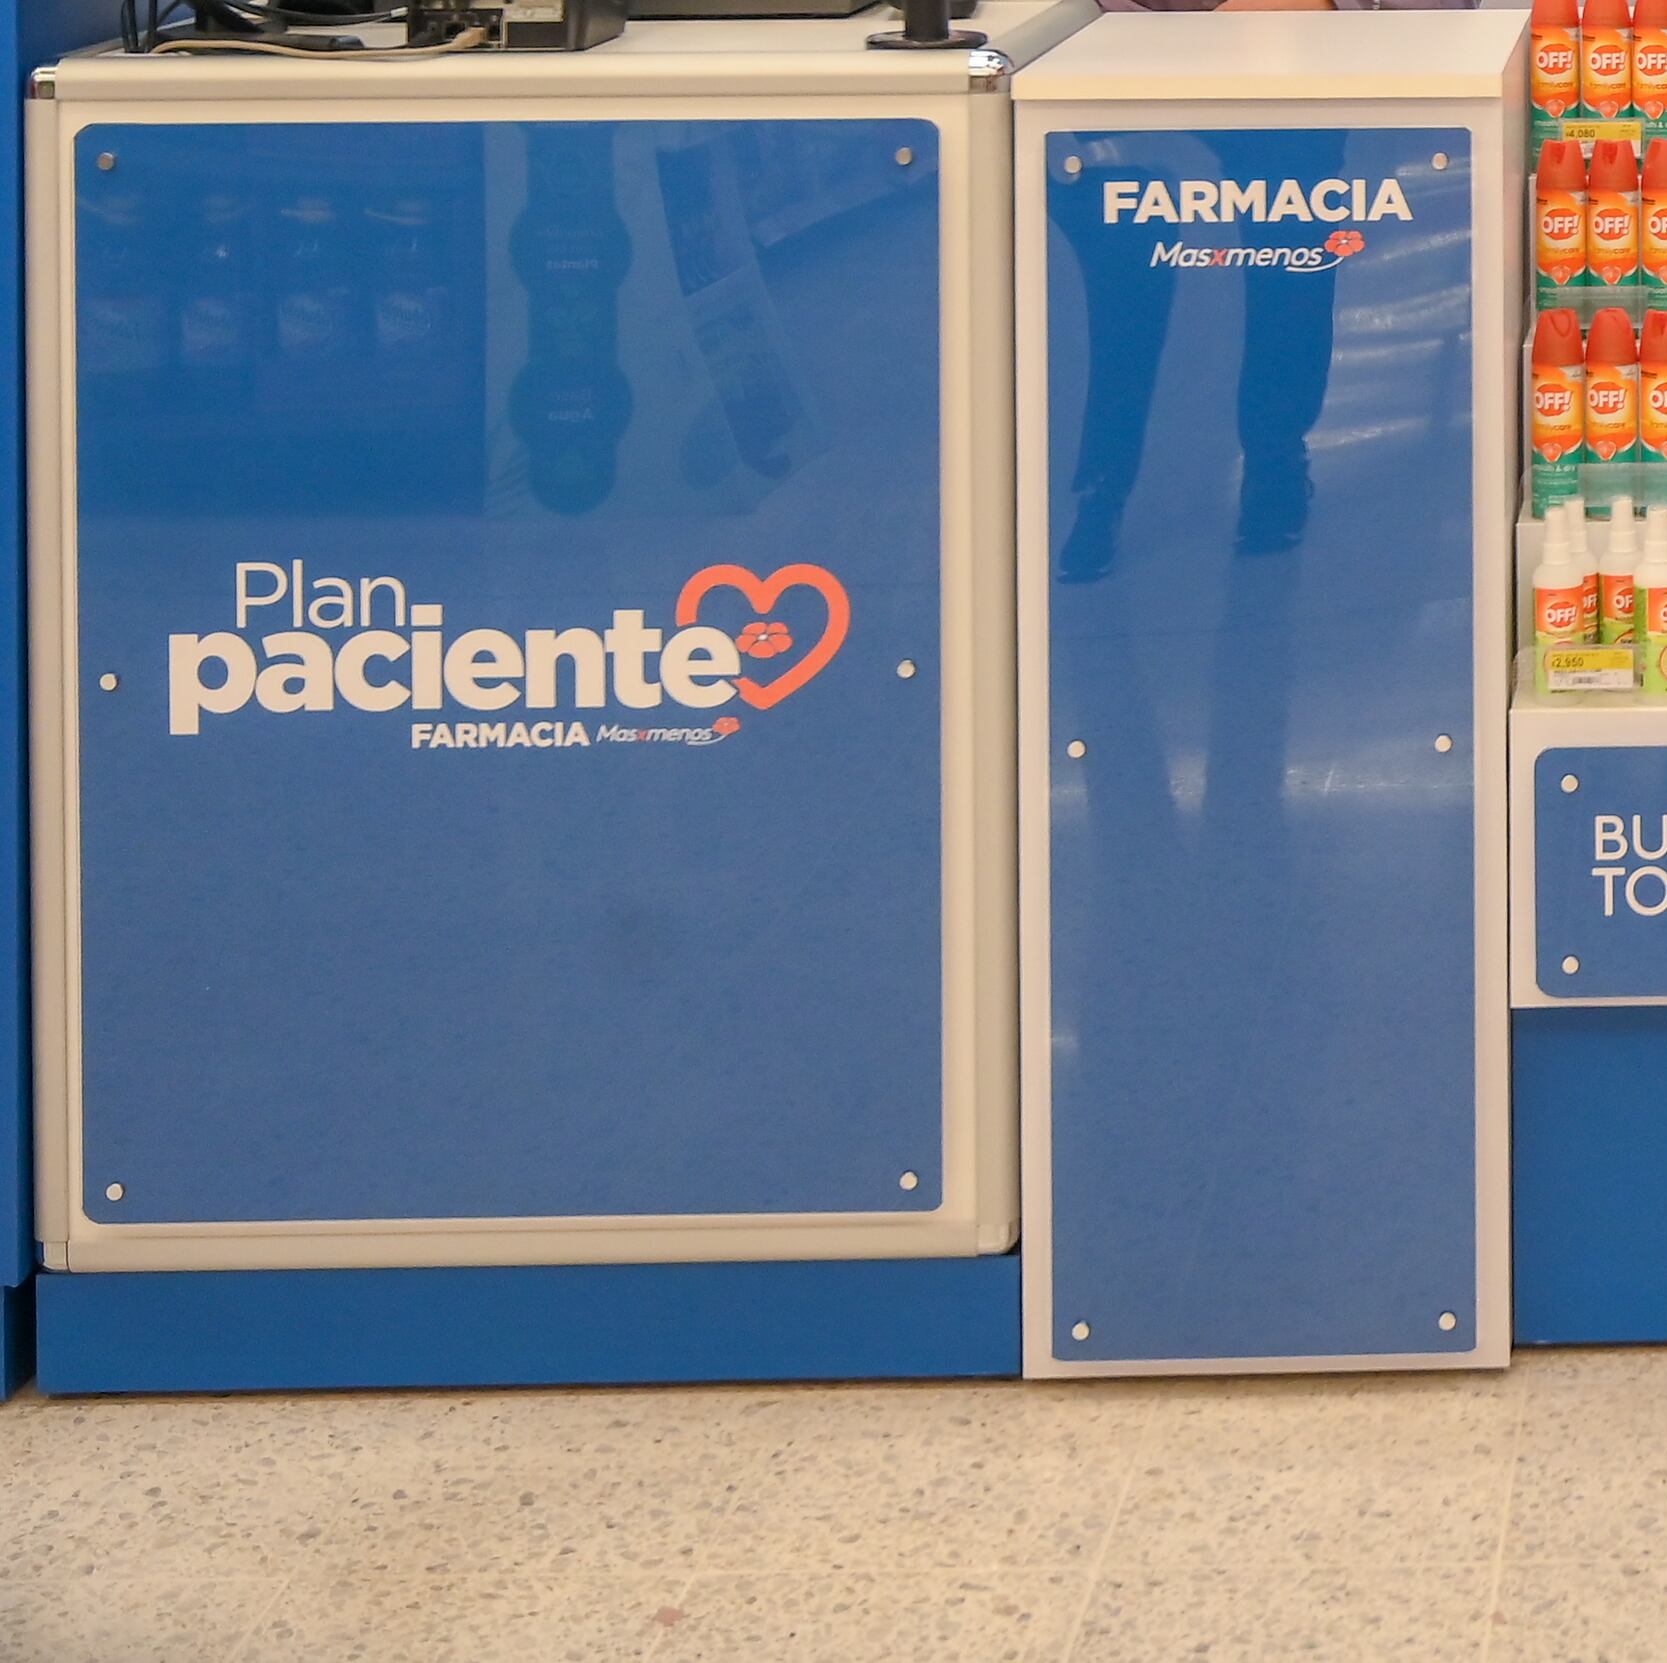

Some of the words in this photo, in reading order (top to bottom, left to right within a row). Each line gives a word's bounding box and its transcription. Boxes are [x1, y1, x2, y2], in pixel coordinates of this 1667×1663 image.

[1536, 49, 1573, 70] OFF!
[1589, 51, 1626, 72] OFF!
[1103, 178, 1413, 224] FARMACIA
[1542, 214, 1579, 235] OFF!
[1150, 241, 1323, 267] Masxmenos
[235, 559, 405, 628] Plan
[168, 604, 741, 735] paciente
[411, 721, 591, 750] FARMACIA
